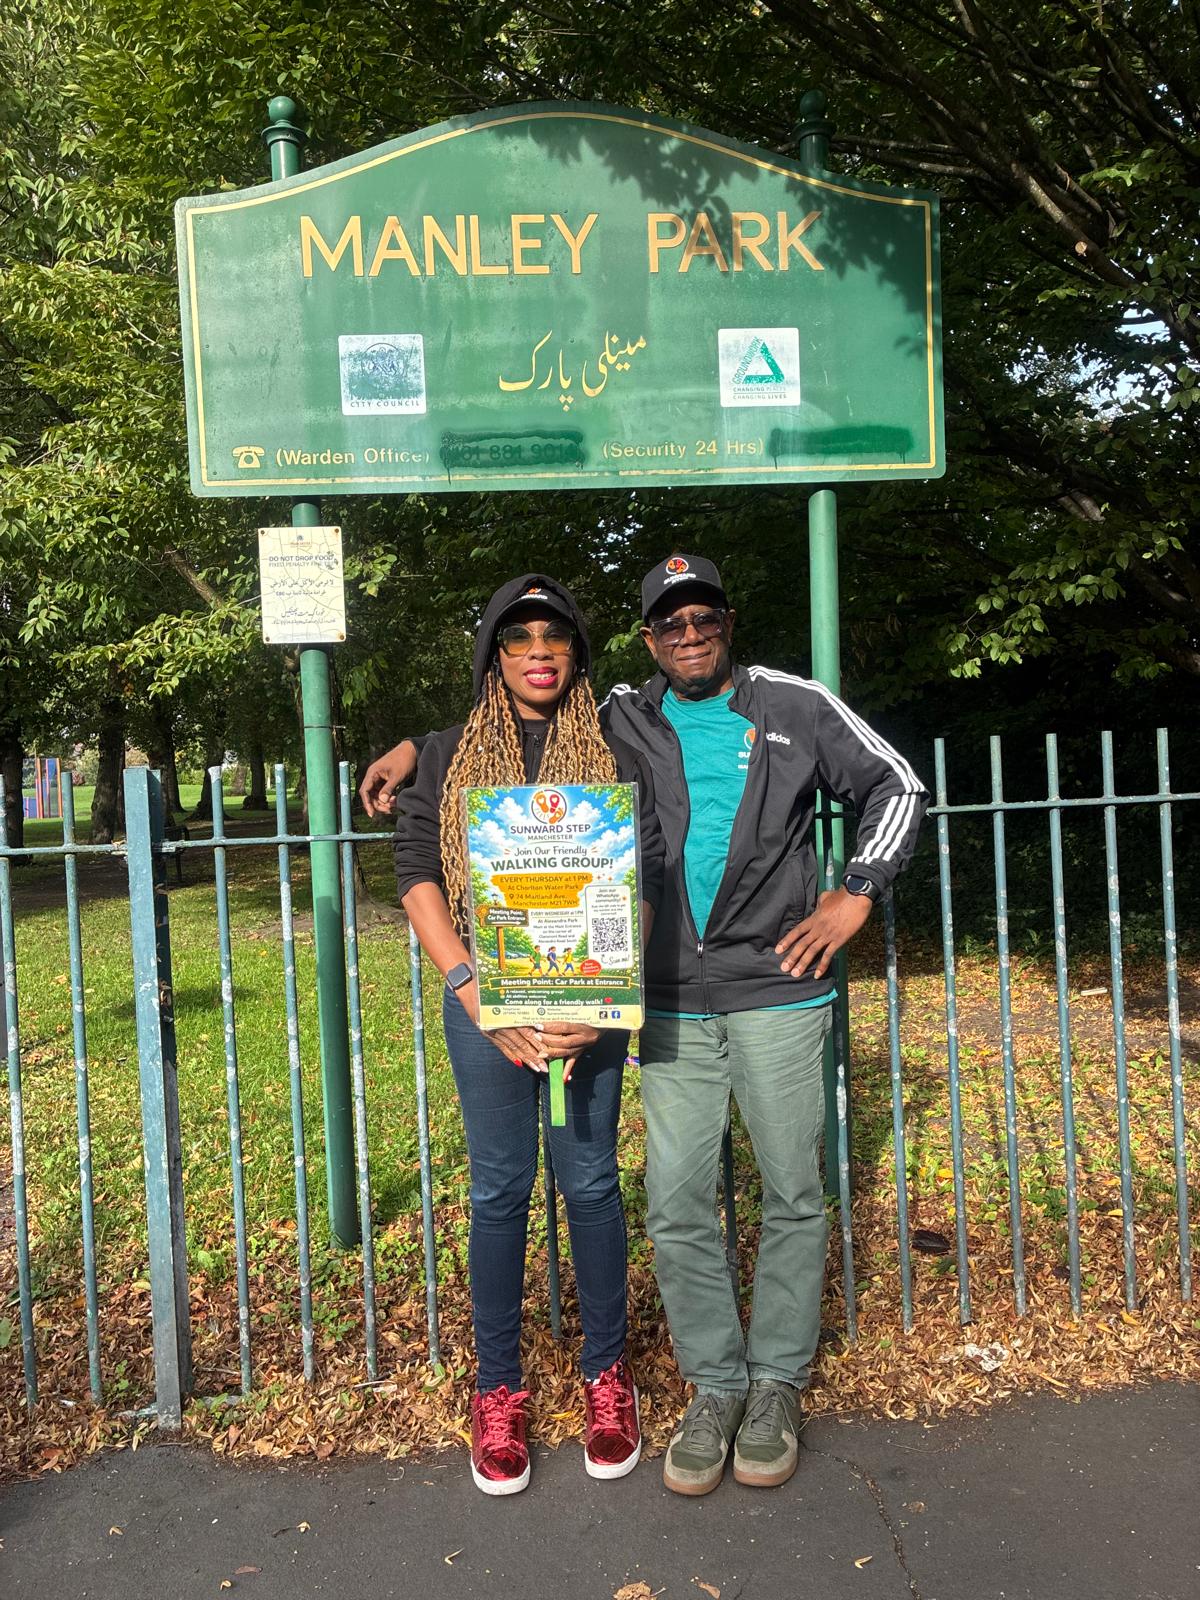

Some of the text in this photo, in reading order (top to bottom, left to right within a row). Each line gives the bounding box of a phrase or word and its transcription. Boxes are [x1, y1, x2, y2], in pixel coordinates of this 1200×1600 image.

[300, 210, 824, 277] MANLEY PARK
[499, 330, 574, 412] پارک
[275, 448, 355, 467] (Warden
[364, 448, 430, 464] Office)
[602, 441, 686, 459] (Security
[695, 440, 717, 455] 24
[727, 439, 763, 456] Hrs)
[510, 824, 591, 834] SUNWARD STEP
[514, 845, 587, 856] Join Our Friendly
[491, 857, 613, 872] WALKING GROUP!
